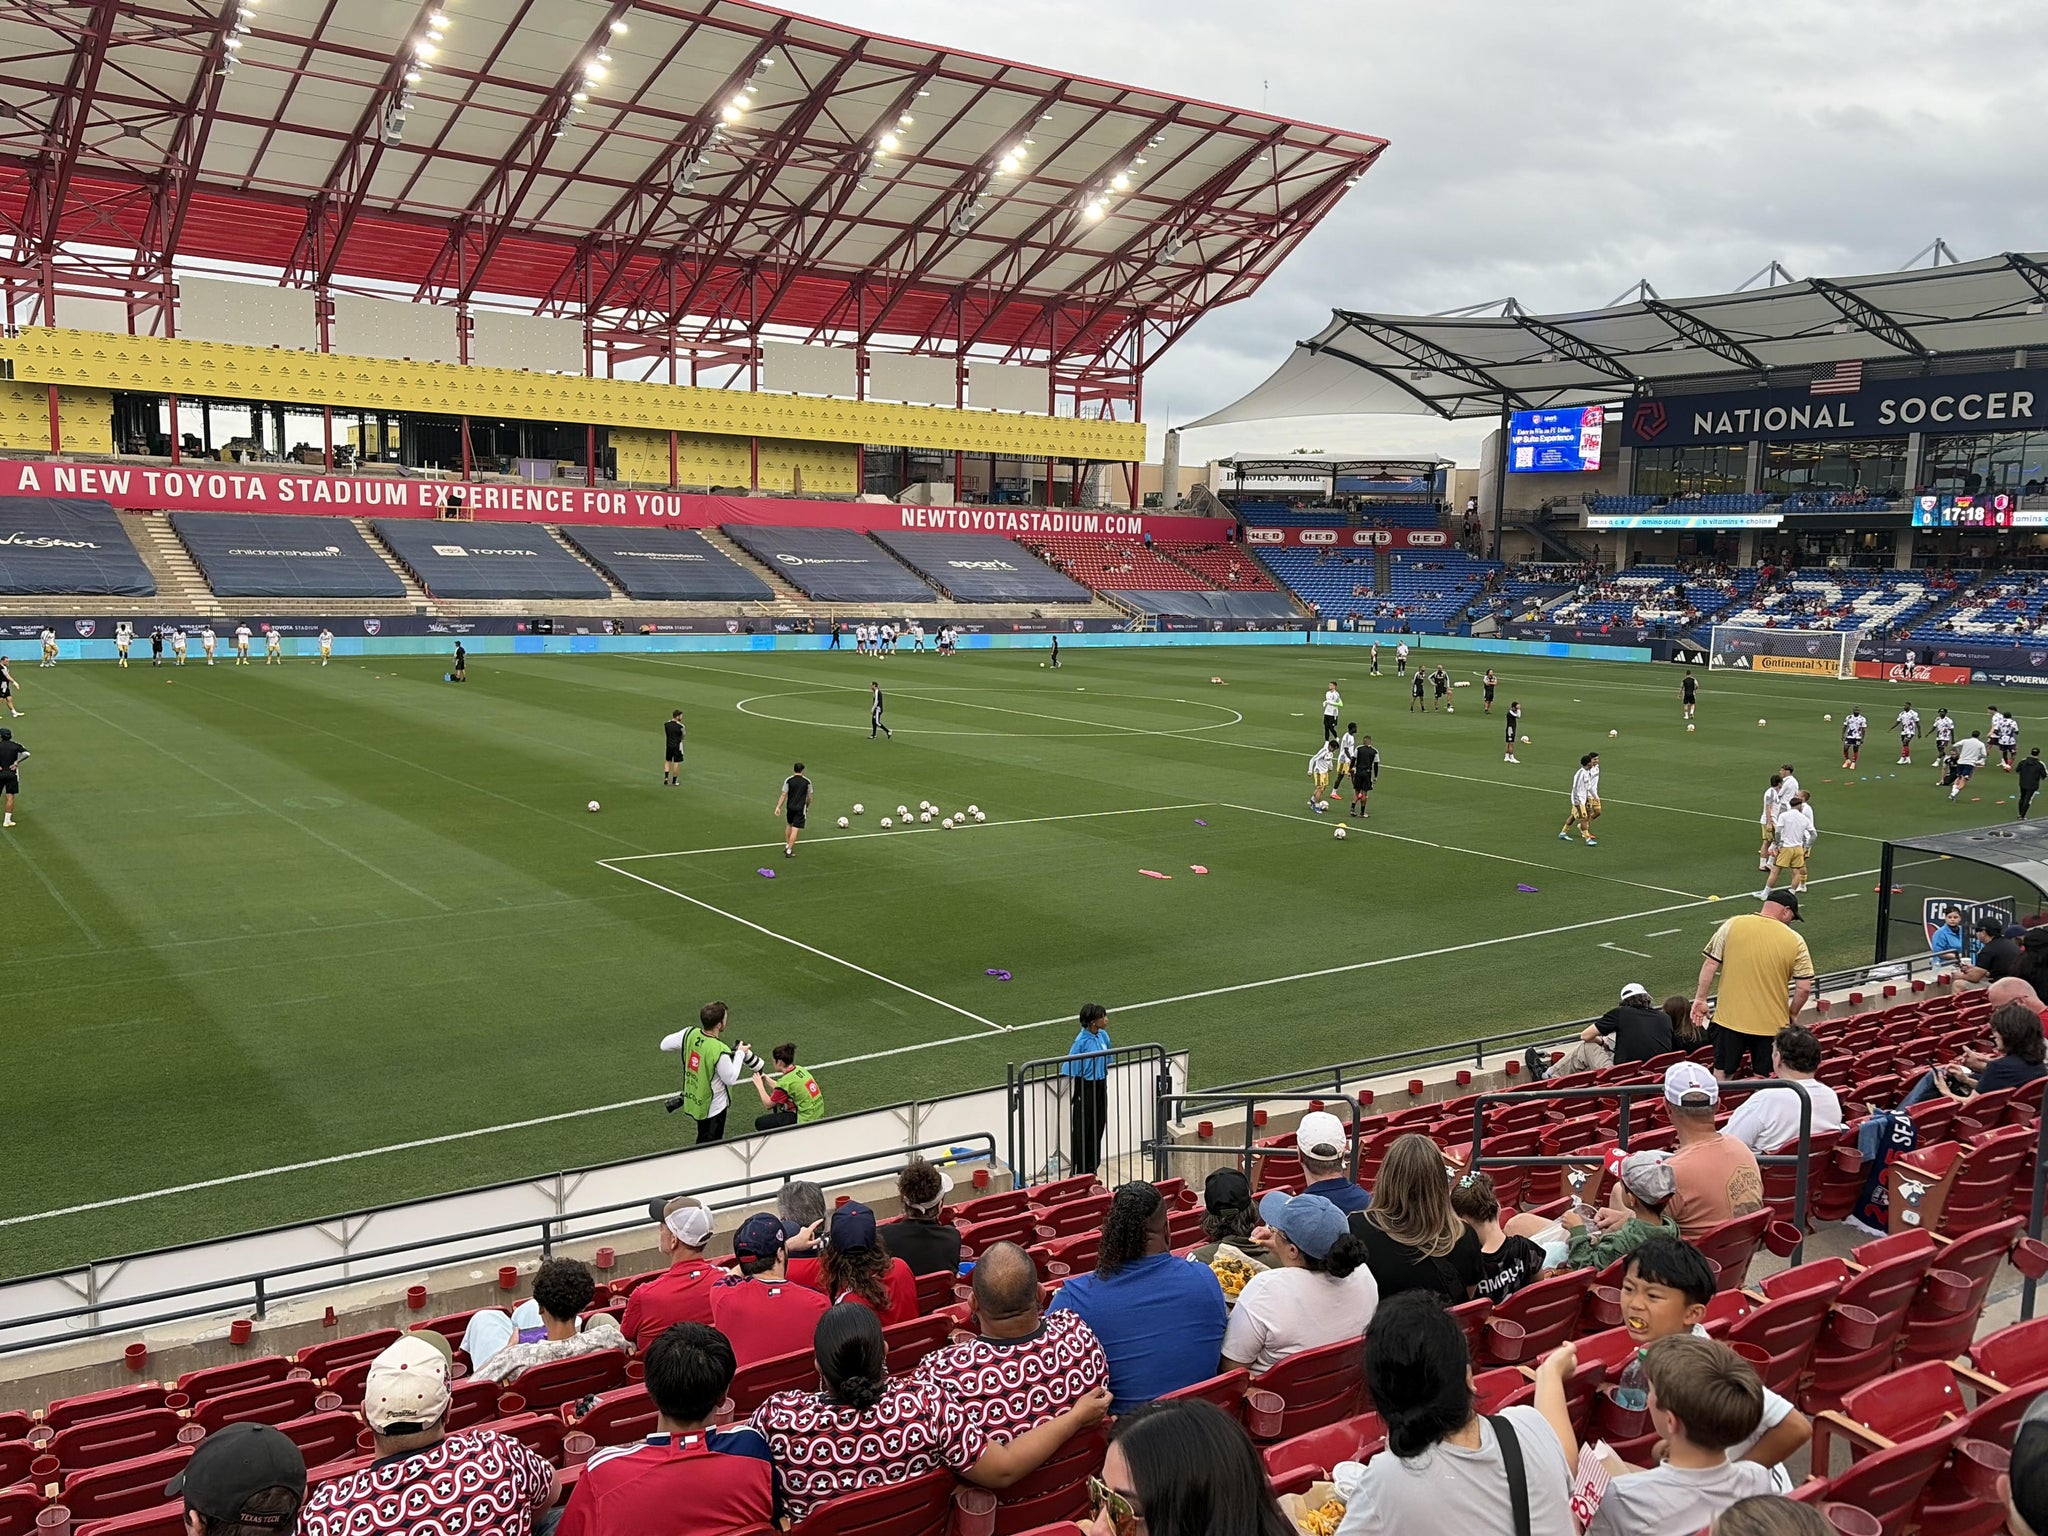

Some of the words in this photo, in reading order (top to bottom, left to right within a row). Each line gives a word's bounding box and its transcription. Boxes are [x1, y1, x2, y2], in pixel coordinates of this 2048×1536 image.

[1693, 403, 1855, 436] NATIONAL
[1878, 391, 2035, 425] SOCCER
[1540, 434, 1575, 443] Experience
[17, 465, 41, 491] A
[53, 467, 131, 495] NEW
[142, 471, 267, 501] TOYOTA
[278, 478, 407, 506] STADIUM
[418, 485, 574, 513] EXPERIENCE
[583, 493, 627, 514] FOR
[635, 495, 681, 517] YOU
[1923, 513, 1931, 524] 0
[1942, 507, 1985, 521] 17:18
[1995, 512, 2005, 523] 0
[901, 508, 1143, 536] NEWTOYOTASTADIUM.COM
[469, 548, 539, 557] TOYOTA
[947, 559, 1014, 570] spark
[1761, 656, 1815, 669] Continental
[1824, 658, 1840, 671] Tir
[2005, 675, 2048, 685] POWERW
[1930, 903, 1946, 920] FC
[240, 1513, 263, 1523] TEXAS
[263, 1515, 281, 1523] TECH
